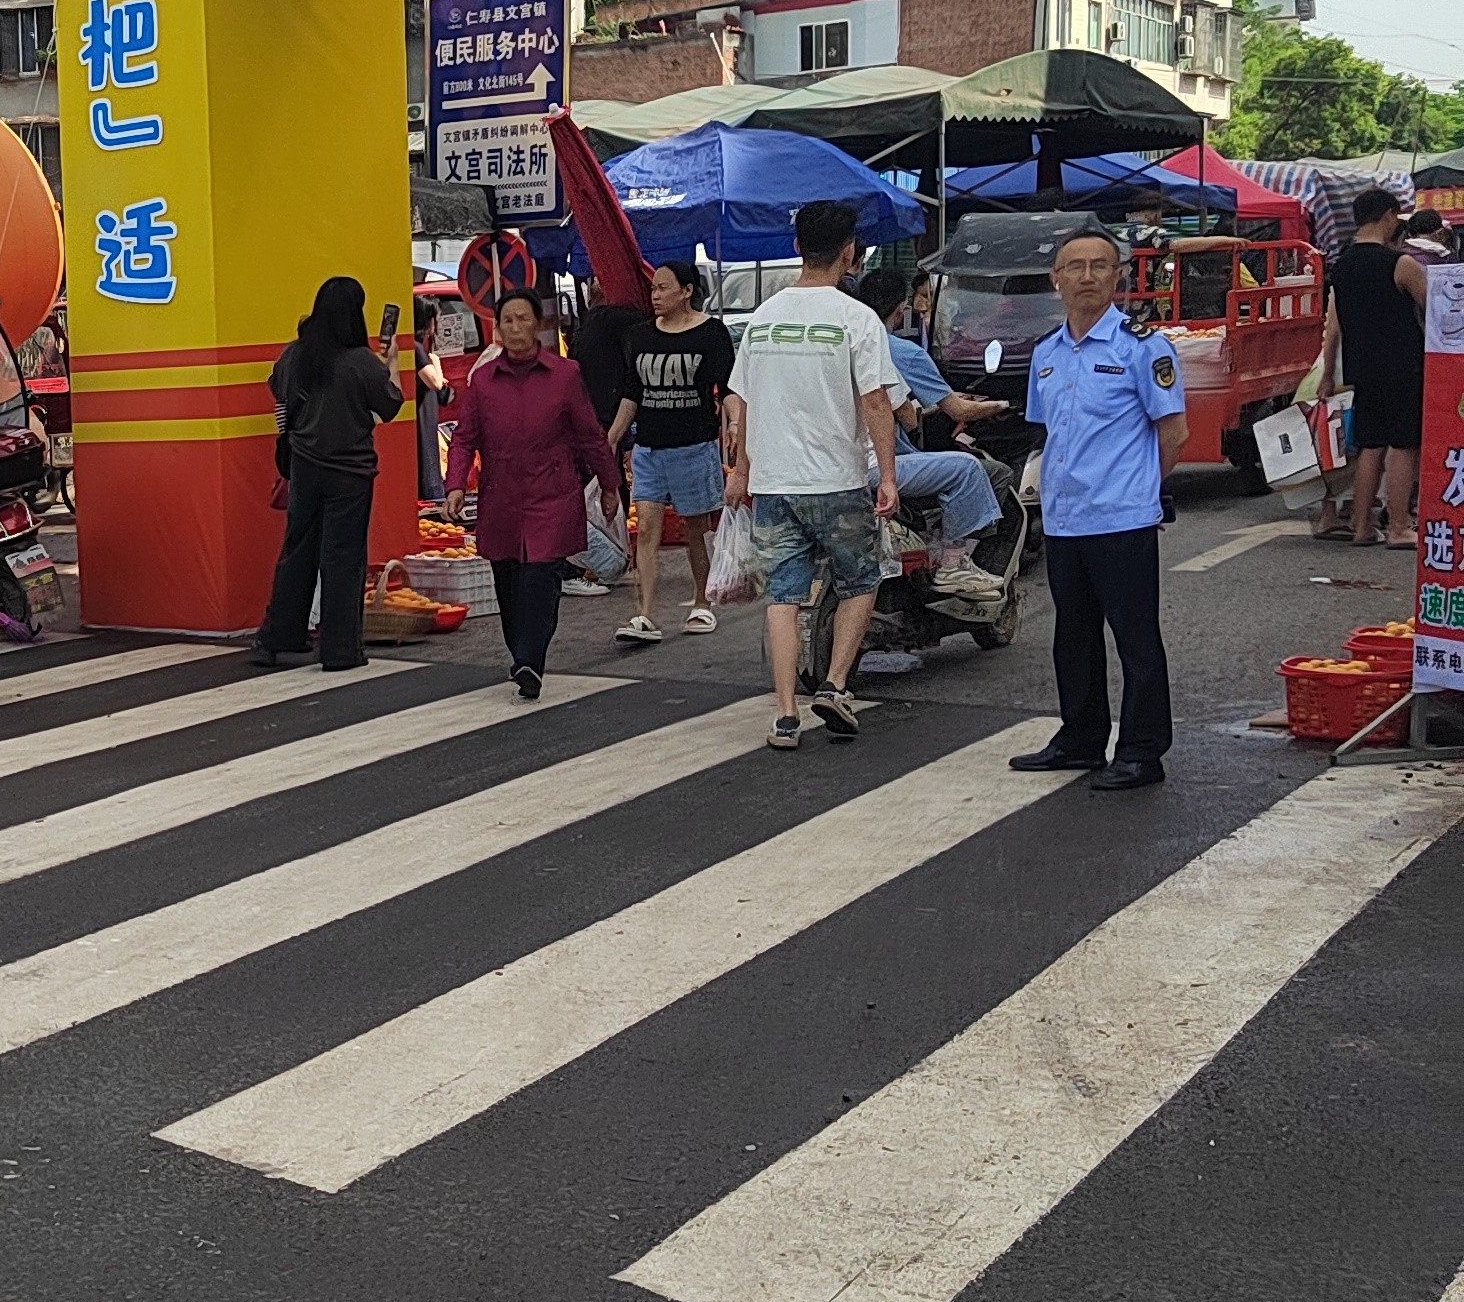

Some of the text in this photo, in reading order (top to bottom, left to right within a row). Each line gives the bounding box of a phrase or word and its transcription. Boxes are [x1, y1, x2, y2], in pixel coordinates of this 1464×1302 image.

[465, 1, 547, 26] 仁寿县文宫镇
[434, 26, 560, 68] 便民服务中心
[444, 143, 549, 181] 文宫司法所
[636, 353, 703, 387] WAY
[1423, 520, 1464, 572] 选
